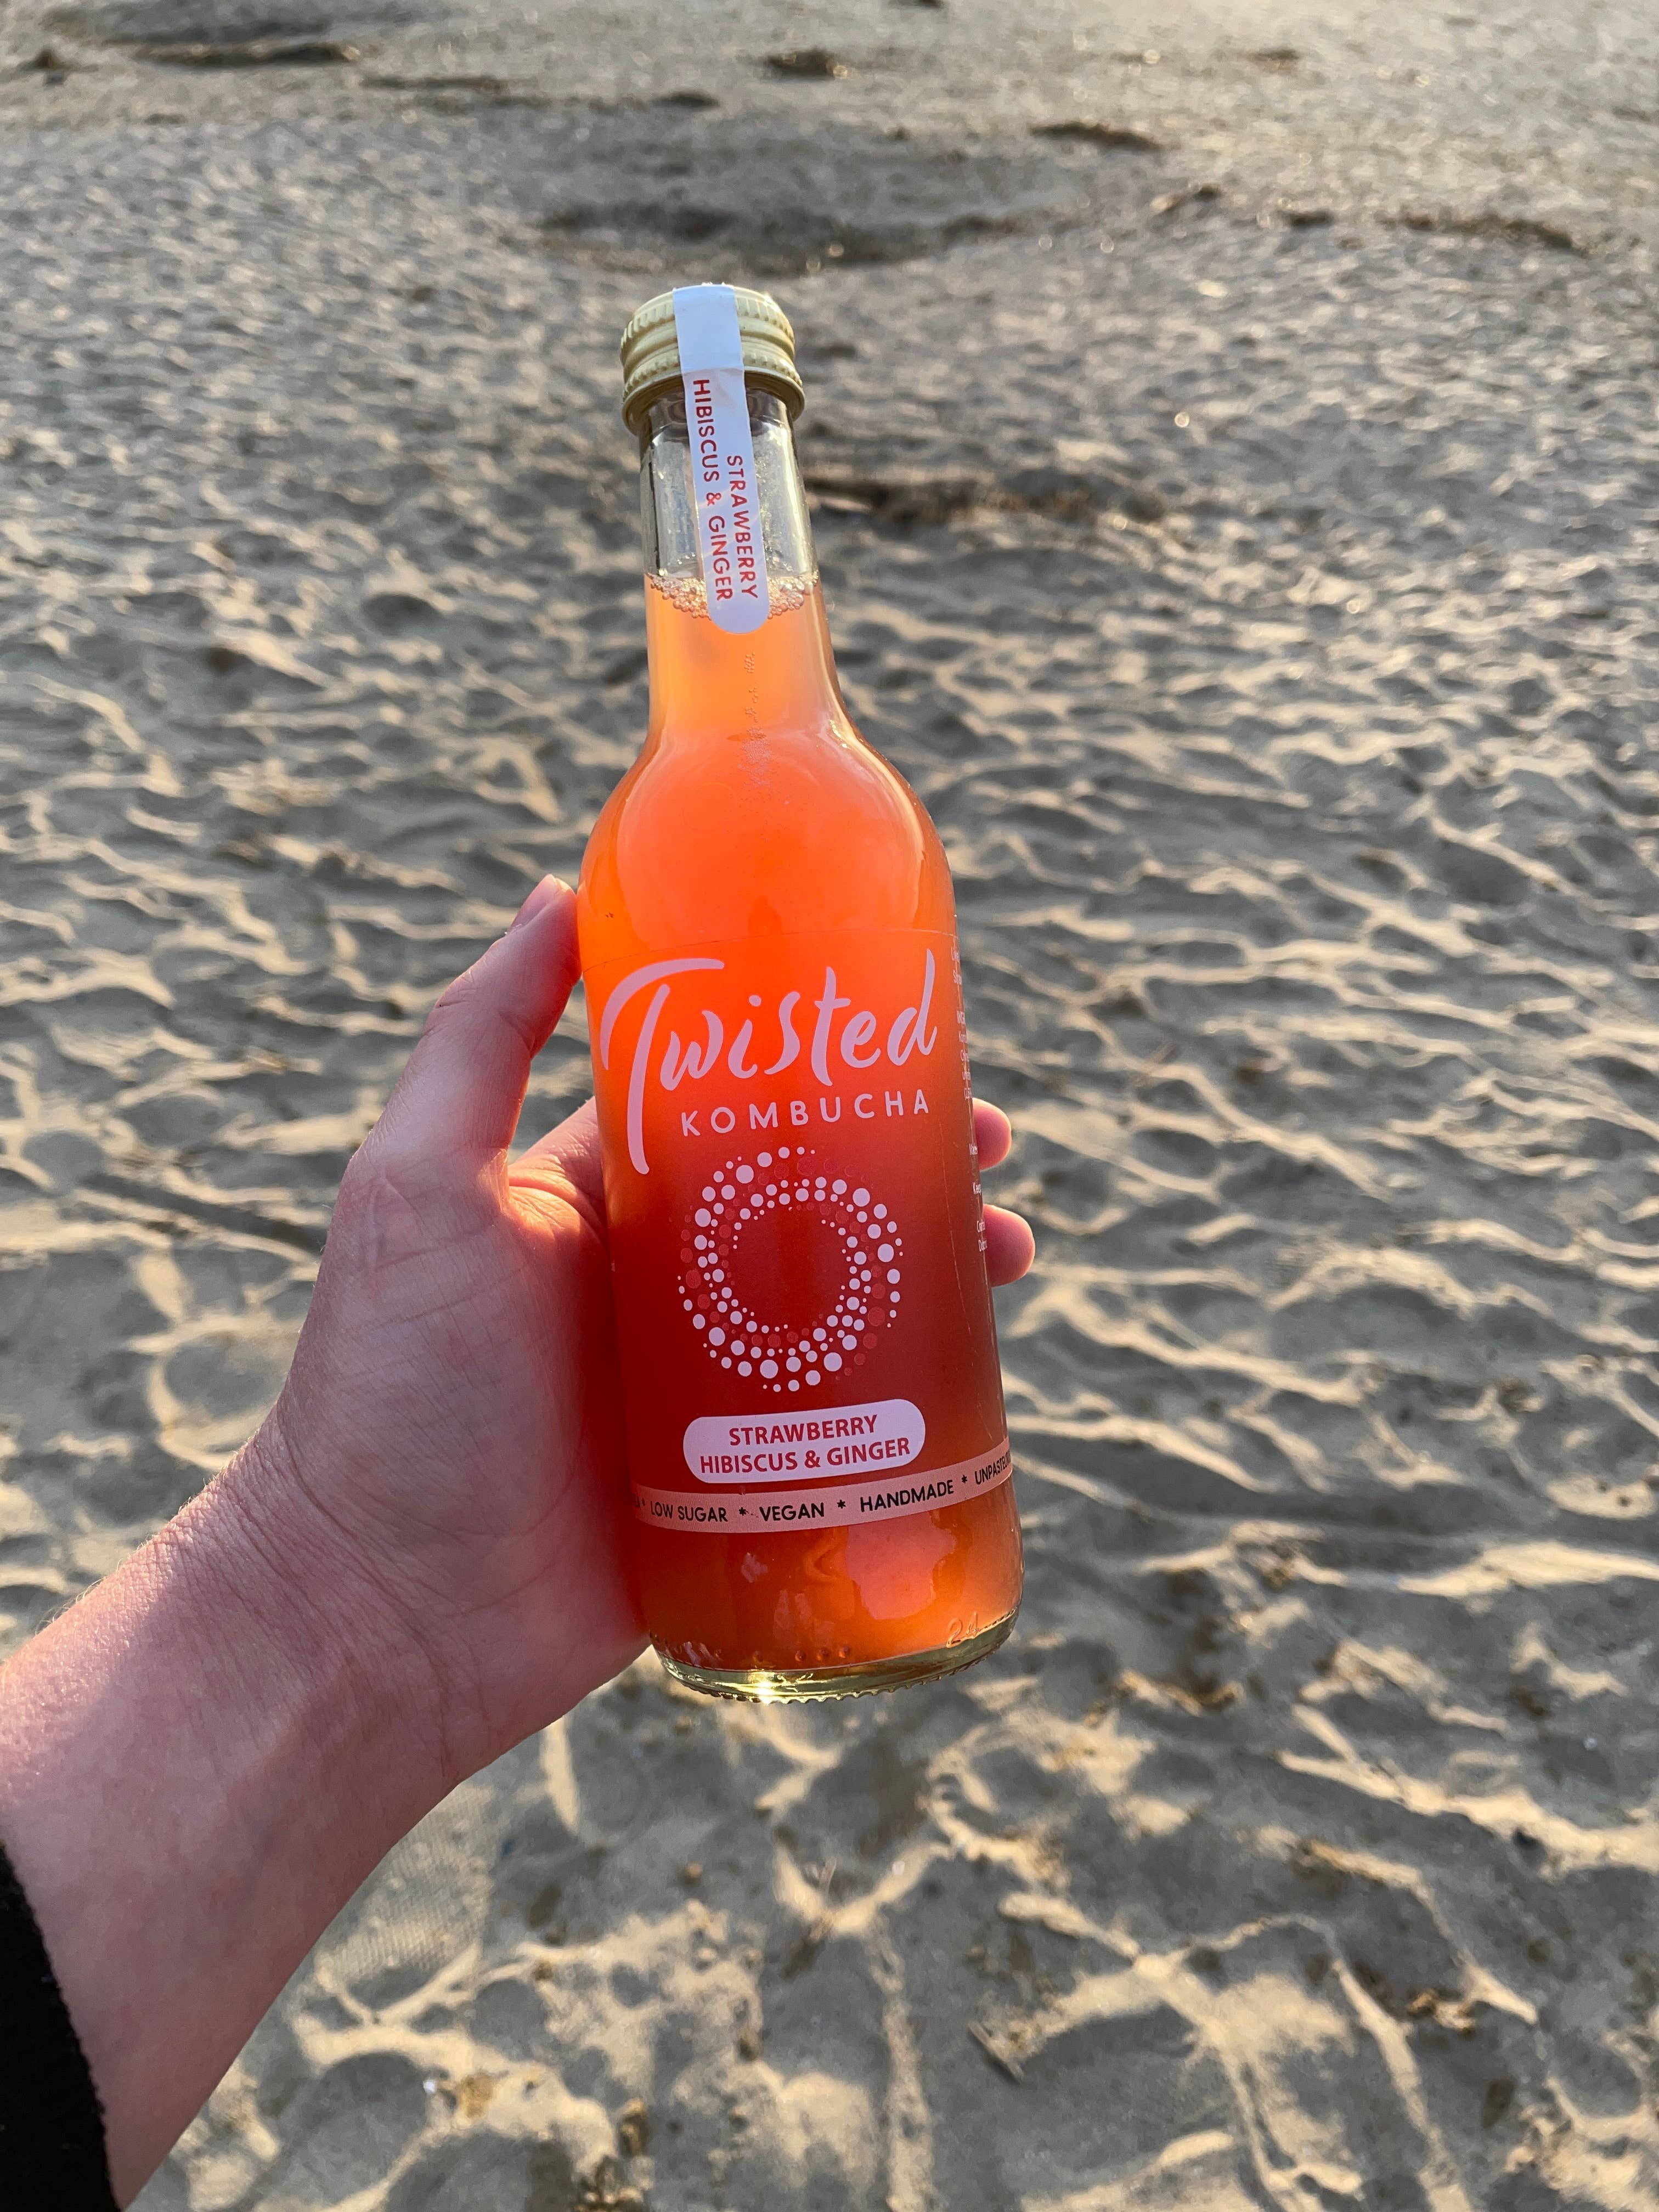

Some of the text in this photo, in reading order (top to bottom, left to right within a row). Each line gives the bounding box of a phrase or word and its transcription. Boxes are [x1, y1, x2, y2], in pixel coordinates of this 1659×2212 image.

[693, 379, 733, 602] HIBISCUS & GINGER
[727, 455, 758, 598] STRAWBERRY
[600, 948, 938, 1175] Twisted
[681, 1088, 929, 1137] KOMBUCHA
[729, 1414, 878, 1446] STRAWBERRY
[700, 1437, 910, 1474] HIBISCUS & GINGER
[650, 1500, 675, 1519] LOW
[678, 1505, 728, 1522] SUGAR
[759, 1502, 825, 1521] VEGAN
[860, 1480, 955, 1513] HANDMADE
